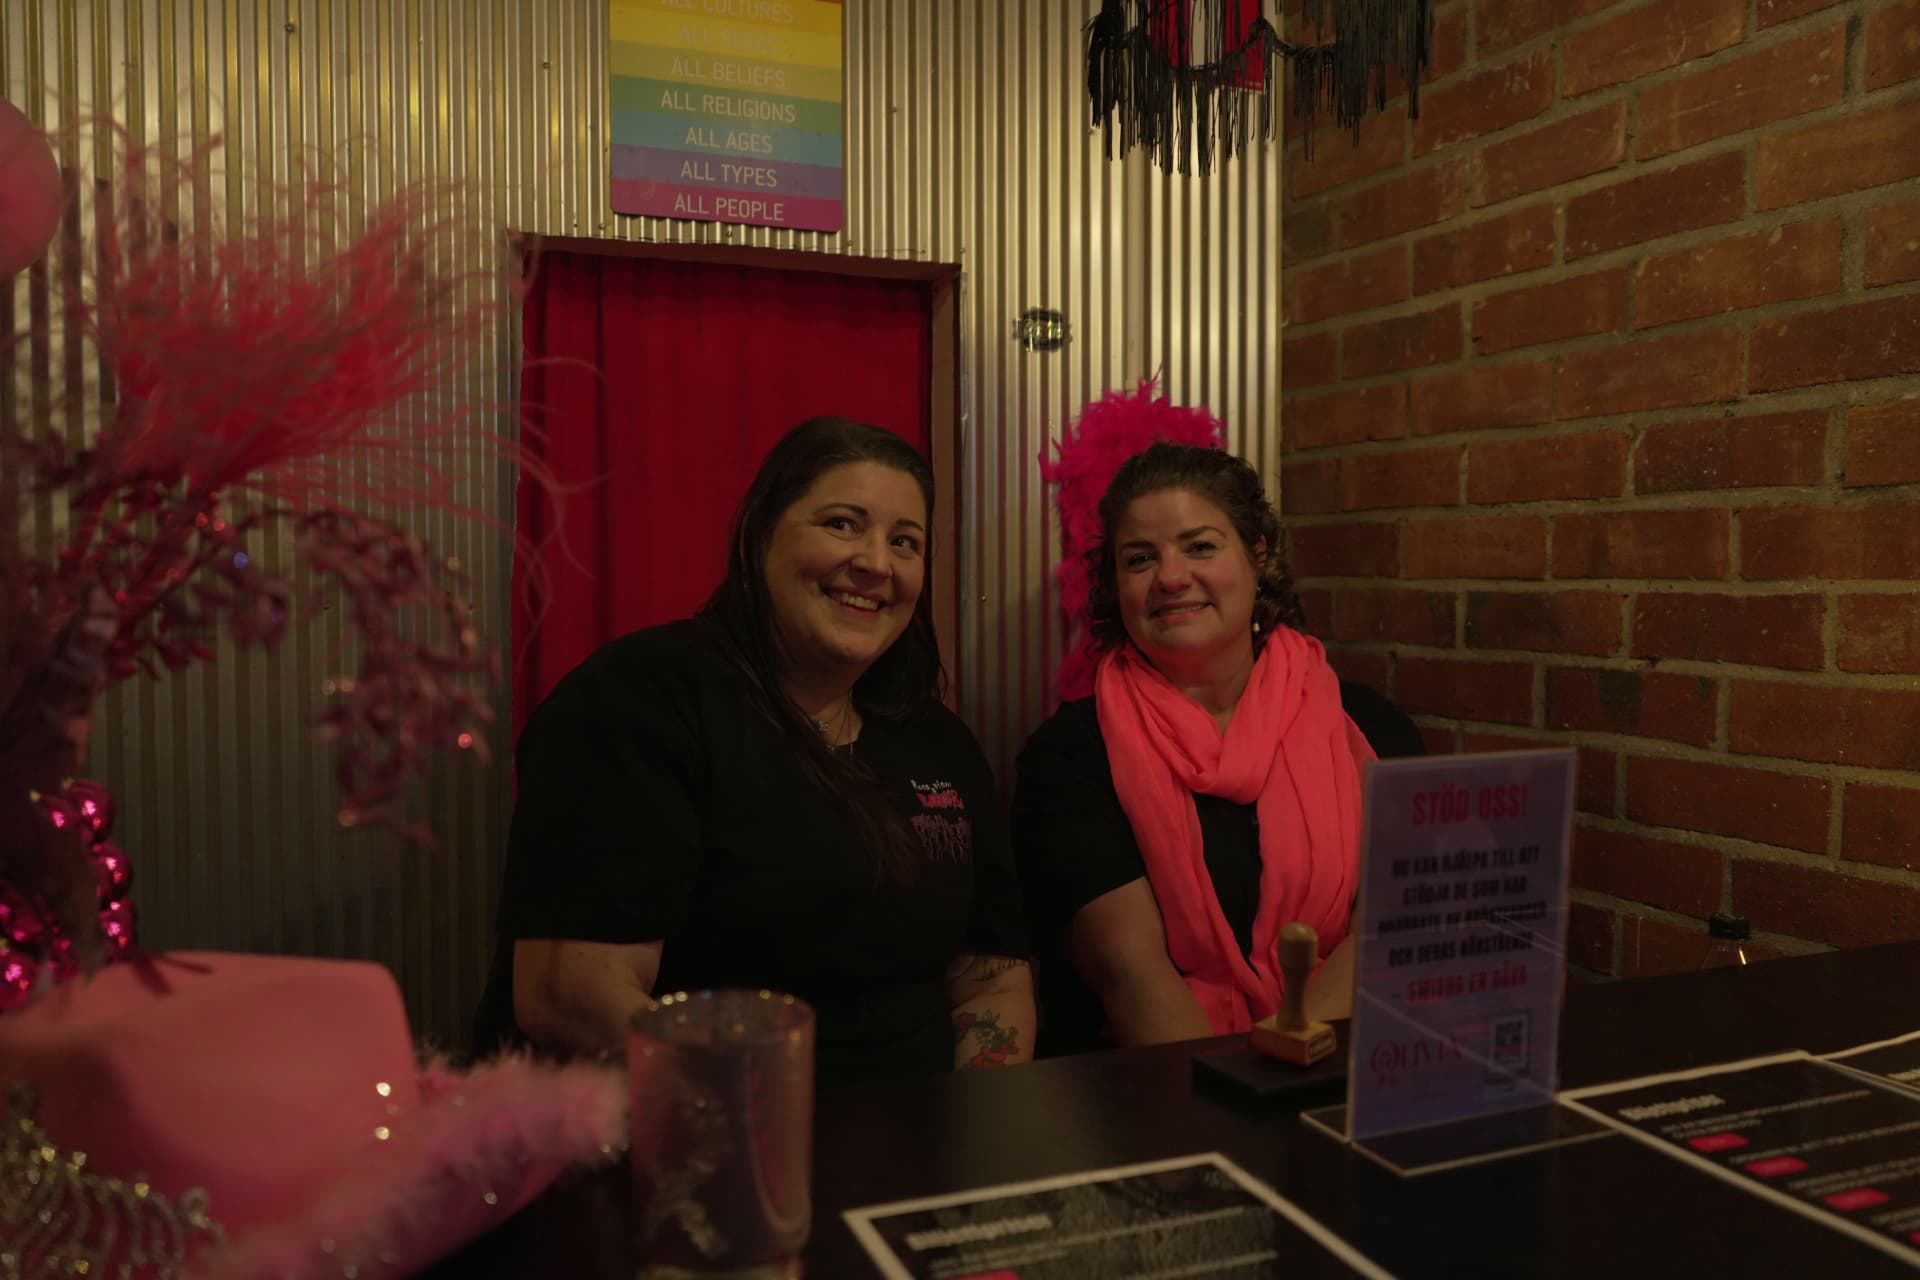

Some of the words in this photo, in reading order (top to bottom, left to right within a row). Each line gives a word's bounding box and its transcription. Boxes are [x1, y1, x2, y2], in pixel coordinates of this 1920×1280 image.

[671, 56, 706, 79] ALL
[713, 61, 785, 89] BELIEFS
[661, 89, 697, 111] ALL
[703, 94, 796, 123] RELIGIONS
[686, 127, 721, 149] ALL
[726, 131, 773, 154] AGES
[681, 160, 716, 182] ALL
[721, 163, 777, 188] TYPES
[674, 193, 709, 215] ALL
[715, 197, 785, 221] PEOPLE
[1412, 783, 1470, 825] STÖD
[1478, 784, 1529, 820] OSS!
